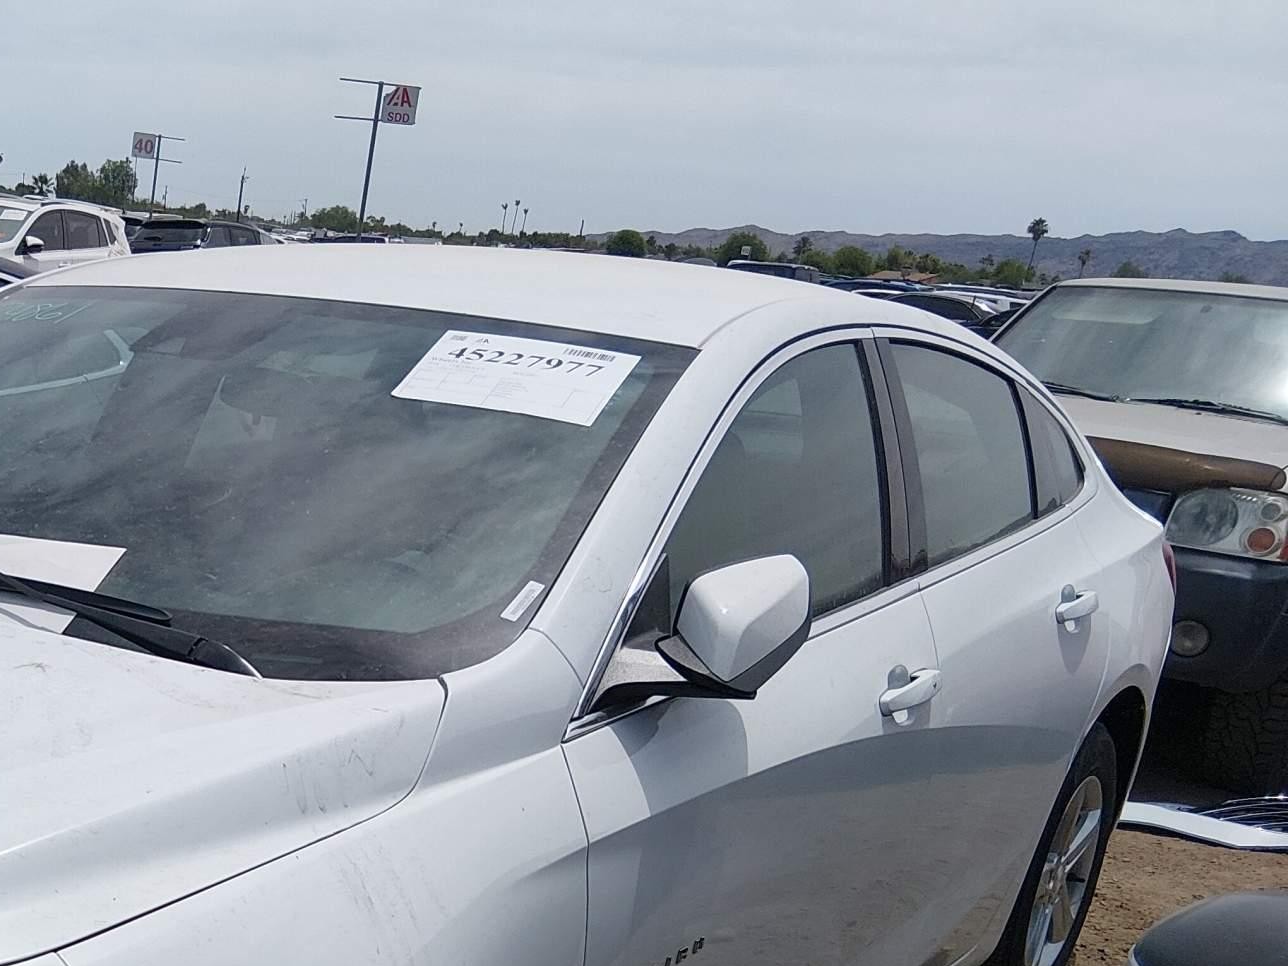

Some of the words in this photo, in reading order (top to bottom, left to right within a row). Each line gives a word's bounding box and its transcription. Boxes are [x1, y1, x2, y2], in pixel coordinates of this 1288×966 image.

[386, 111, 410, 123] SDD
[134, 138, 154, 154] 40
[447, 346, 605, 377] 45227977
